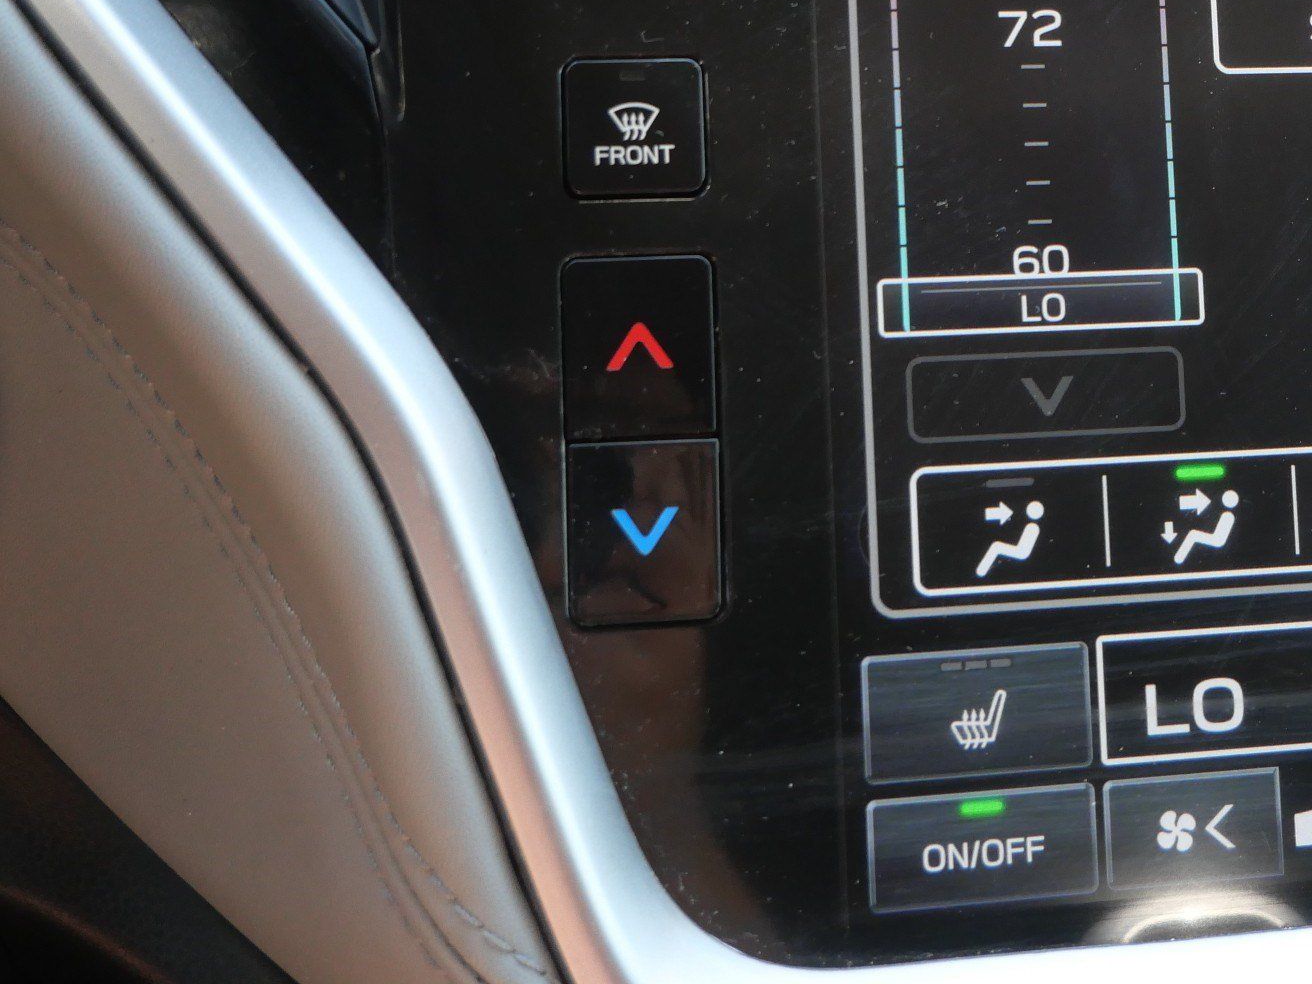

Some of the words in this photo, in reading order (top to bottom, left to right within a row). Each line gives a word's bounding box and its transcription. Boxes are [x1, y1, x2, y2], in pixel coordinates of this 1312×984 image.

[998, 10, 1062, 47] 72
[595, 144, 675, 165] FRONT
[1012, 244, 1070, 275] 60
[1022, 293, 1065, 322] LO
[1145, 678, 1244, 737] LO
[923, 836, 1044, 873] ON/OFF
